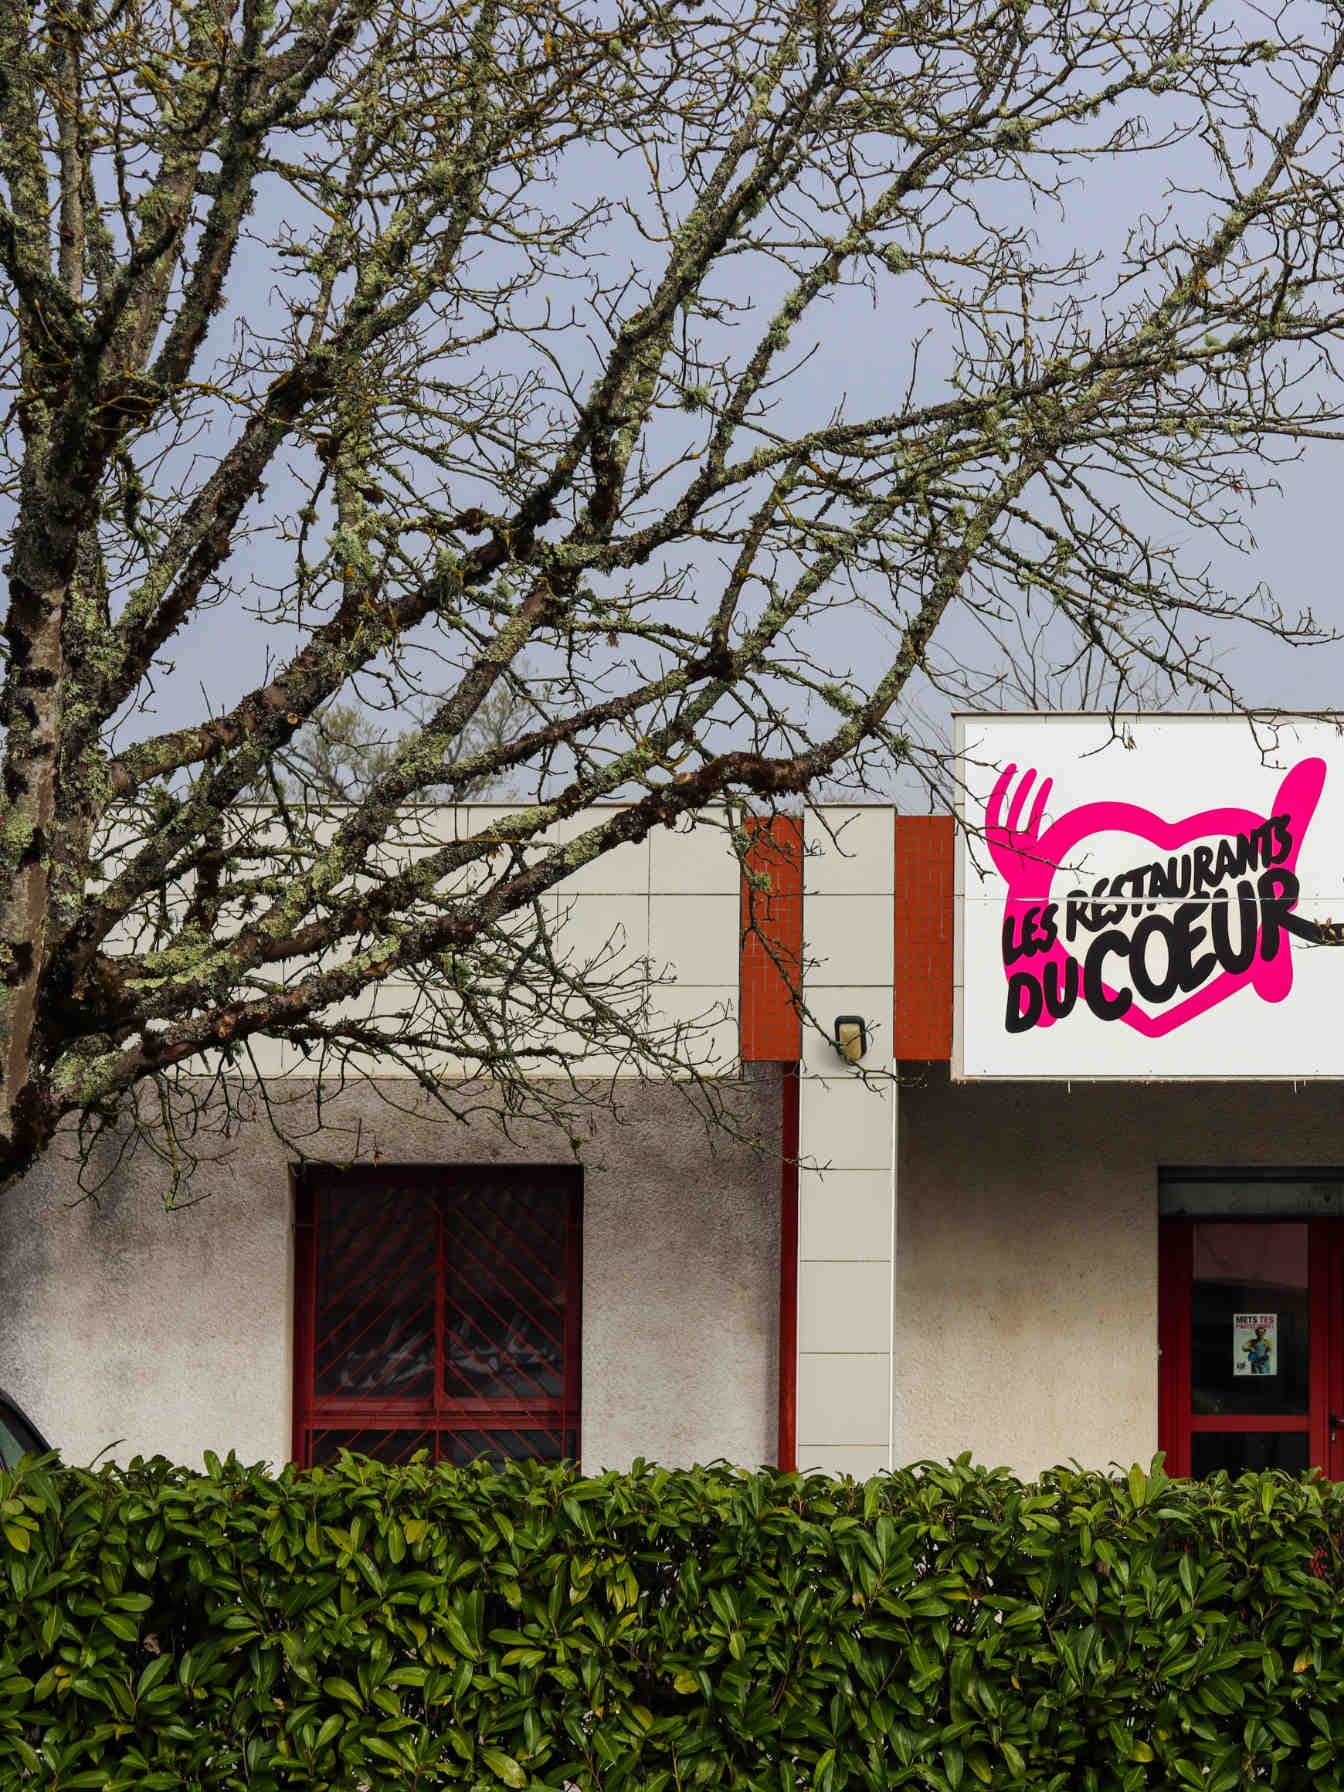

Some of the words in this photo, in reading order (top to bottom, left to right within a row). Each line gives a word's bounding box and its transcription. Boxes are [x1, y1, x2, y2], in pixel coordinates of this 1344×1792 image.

[1002, 903, 1058, 965] LES
[1066, 814, 1292, 942] RESTAURANTS
[1005, 956, 1079, 1033] DU
[1235, 1315, 1258, 1324] METS
